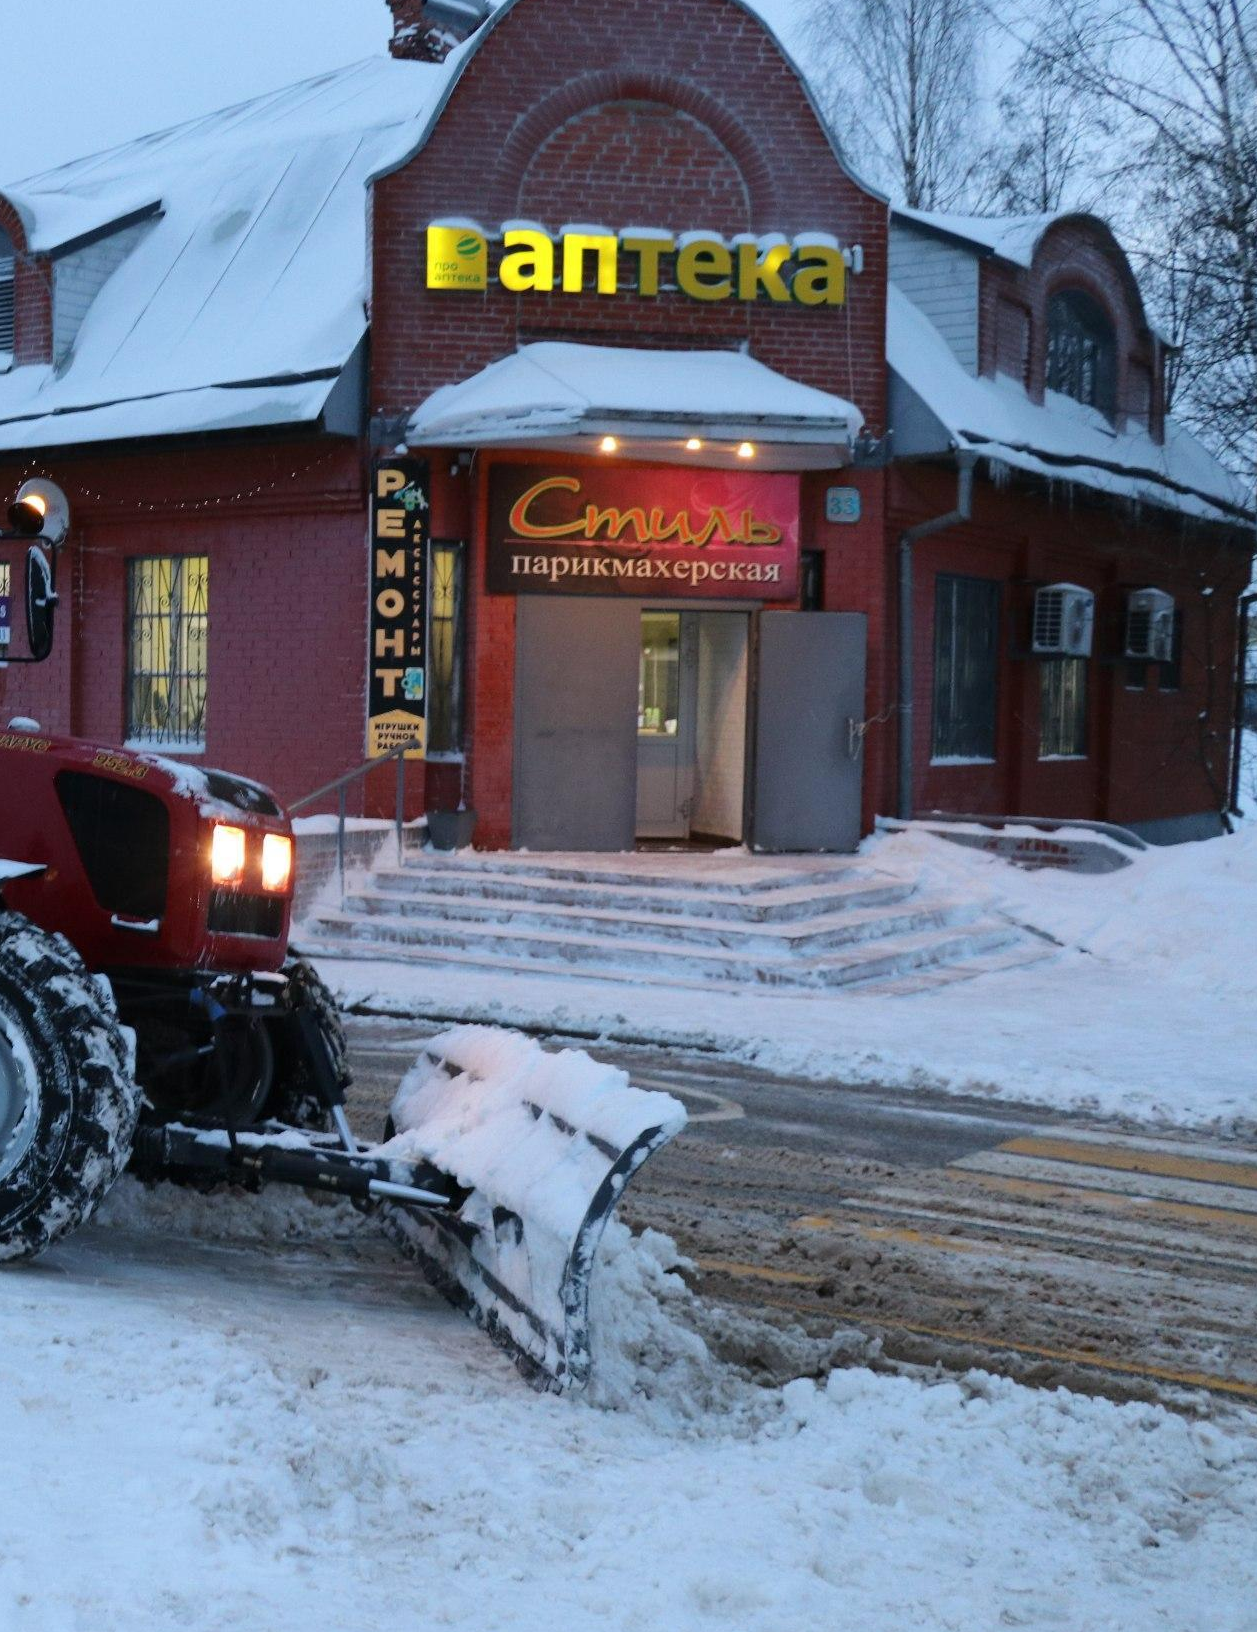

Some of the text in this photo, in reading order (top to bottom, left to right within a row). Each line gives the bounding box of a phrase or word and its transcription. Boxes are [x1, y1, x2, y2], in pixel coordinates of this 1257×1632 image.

[434, 261, 458, 272] про
[434, 273, 481, 283] аптека
[499, 230, 844, 305] аптека
[509, 476, 781, 547] Стиль
[375, 469, 405, 697] РЕМОНТ
[410, 519, 422, 656] АКСЕССУАРЫ
[511, 554, 781, 588] парикмахерская
[374, 722, 420, 731] ИГРУШКИ
